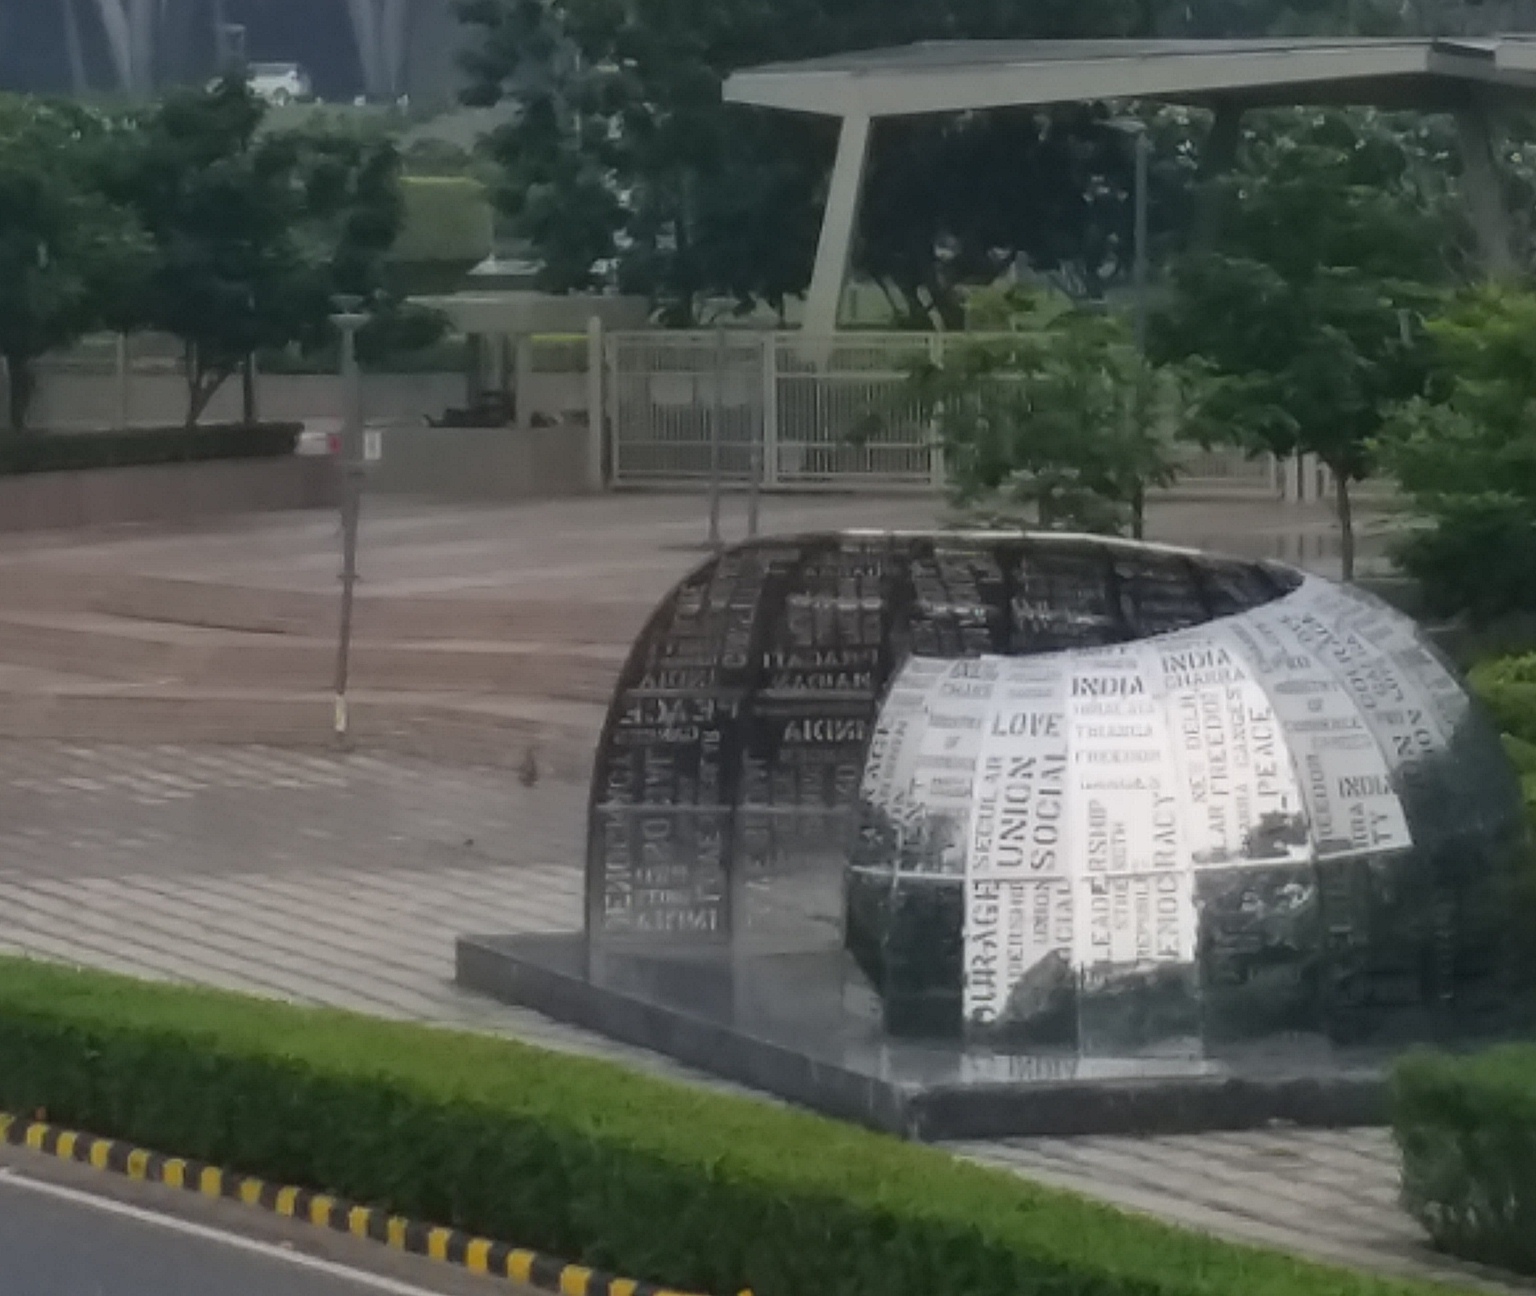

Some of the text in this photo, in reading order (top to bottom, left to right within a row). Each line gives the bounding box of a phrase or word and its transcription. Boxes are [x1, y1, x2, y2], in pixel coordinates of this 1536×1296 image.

[1071, 675, 1145, 699] INDIA
[1161, 647, 1232, 675] INDIA
[991, 711, 1064, 738] LOVE
[1248, 707, 1280, 799] PEACE
[972, 756, 1003, 871] SECULAR
[995, 756, 1037, 868] UNION
[1029, 753, 1069, 872] SOCIAL
[1151, 789, 1182, 960] EMOCRACY
[968, 878, 1002, 1028] OURAGE
